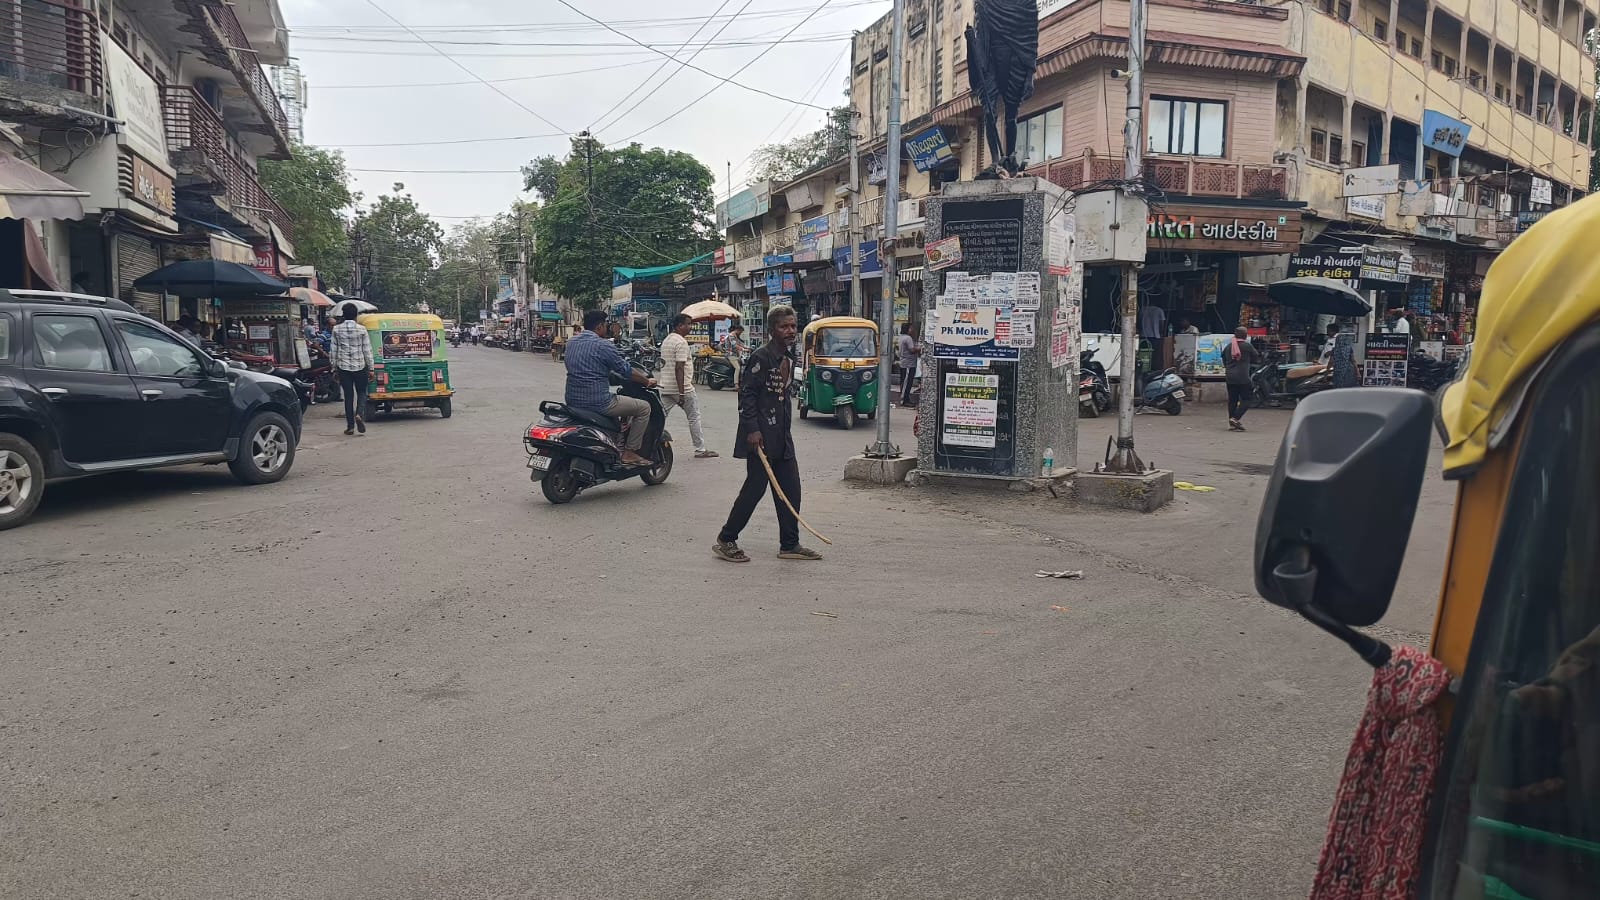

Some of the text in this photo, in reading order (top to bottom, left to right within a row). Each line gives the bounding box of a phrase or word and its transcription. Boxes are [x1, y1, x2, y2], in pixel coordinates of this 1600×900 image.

[911, 129, 944, 154] Regard
[1292, 256, 1321, 265] ગાયત્રી
[1296, 268, 1319, 277] કવર
[941, 327, 989, 335] PK Mobile
